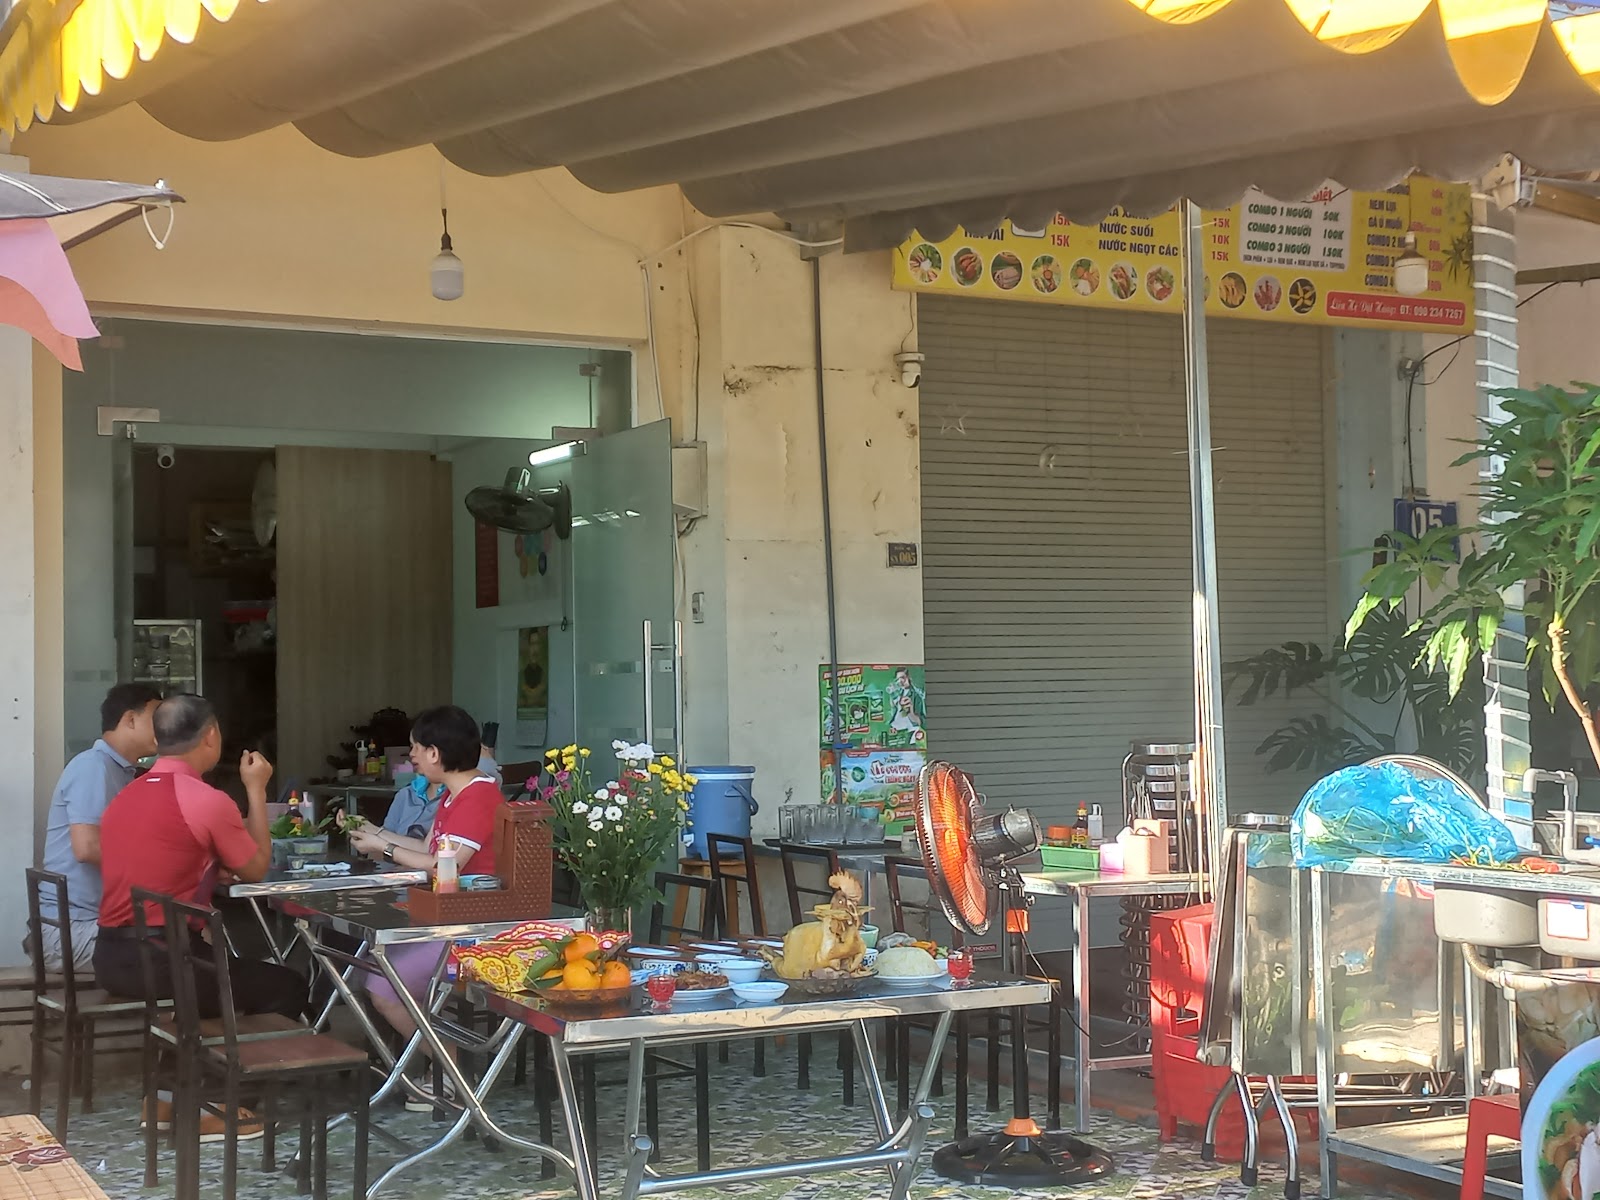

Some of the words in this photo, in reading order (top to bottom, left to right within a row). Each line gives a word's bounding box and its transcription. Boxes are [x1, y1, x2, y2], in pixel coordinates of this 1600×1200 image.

[1248, 203, 1277, 216] COMBO
[1280, 207, 1284, 216] 1
[1323, 211, 1339, 221] 50K
[1100, 222, 1127, 235] NƯỚC
[1131, 224, 1153, 237] SUỐI
[1247, 222, 1276, 233] COMBO
[1277, 225, 1284, 235] 2
[1323, 229, 1344, 240] 100K
[1051, 234, 1070, 247] 15K
[1099, 239, 1126, 252] NƯỚC
[1129, 242, 1155, 256] NGỌT
[1159, 244, 1178, 256] CÁC
[1212, 234, 1229, 245] 10K
[1212, 251, 1229, 261] 15K
[1247, 240, 1275, 252] COMBO
[1277, 243, 1282, 253] 3
[1323, 247, 1343, 258] 150K
[1411, 506, 1443, 540] 05
